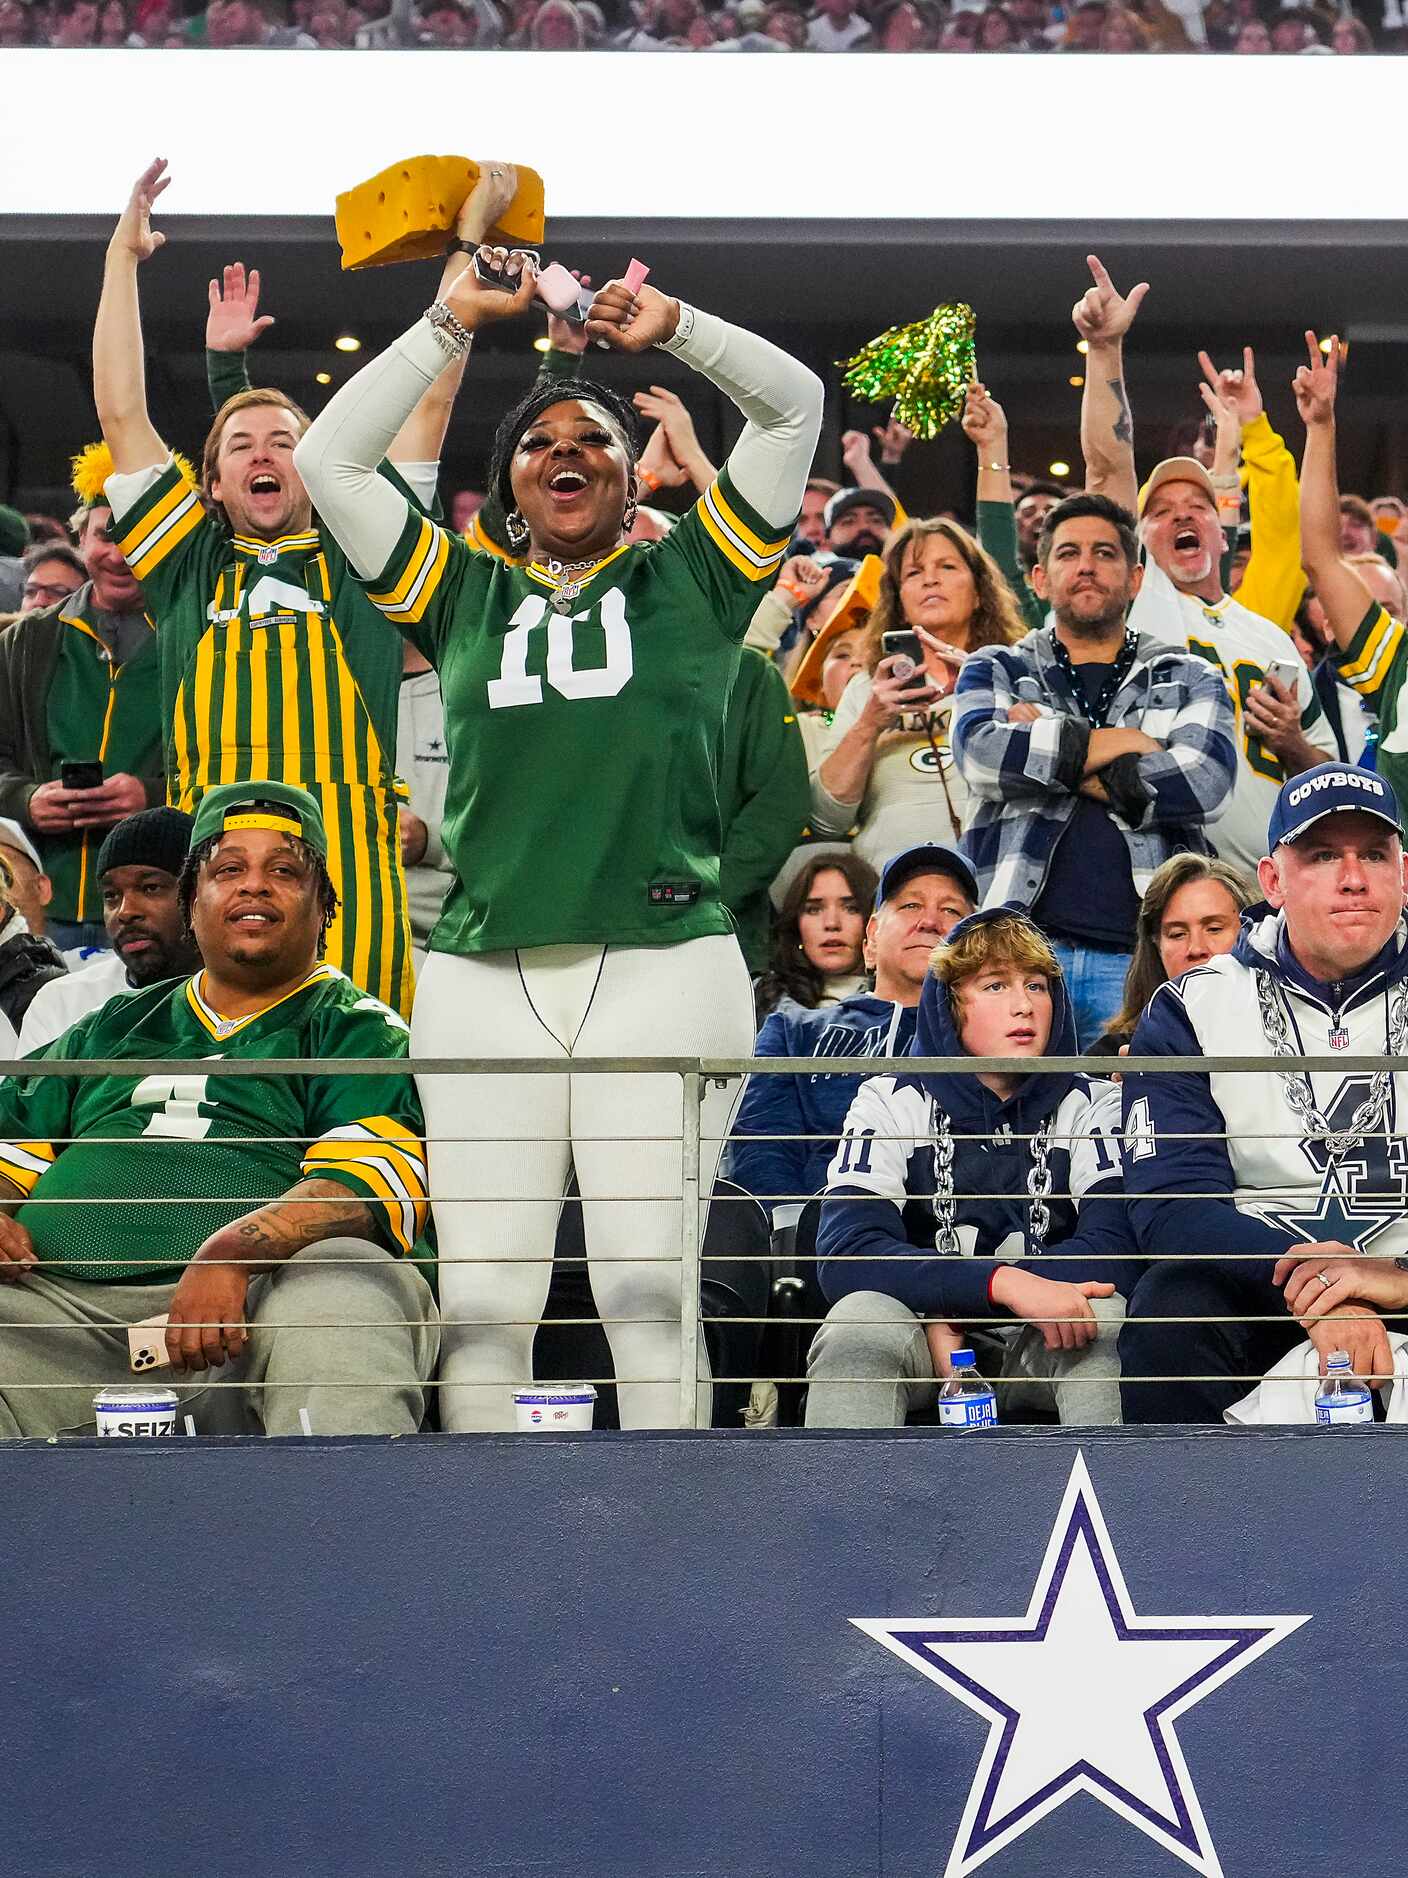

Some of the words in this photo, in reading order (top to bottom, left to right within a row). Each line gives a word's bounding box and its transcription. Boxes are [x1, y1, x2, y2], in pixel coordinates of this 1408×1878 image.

[487, 587, 634, 709] 10
[1288, 772, 1385, 806] COWBOYS
[1331, 1036, 1348, 1047] NFL
[1124, 1096, 1157, 1164] 4
[838, 1127, 877, 1174] 11
[968, 1404, 991, 1422] DEJA
